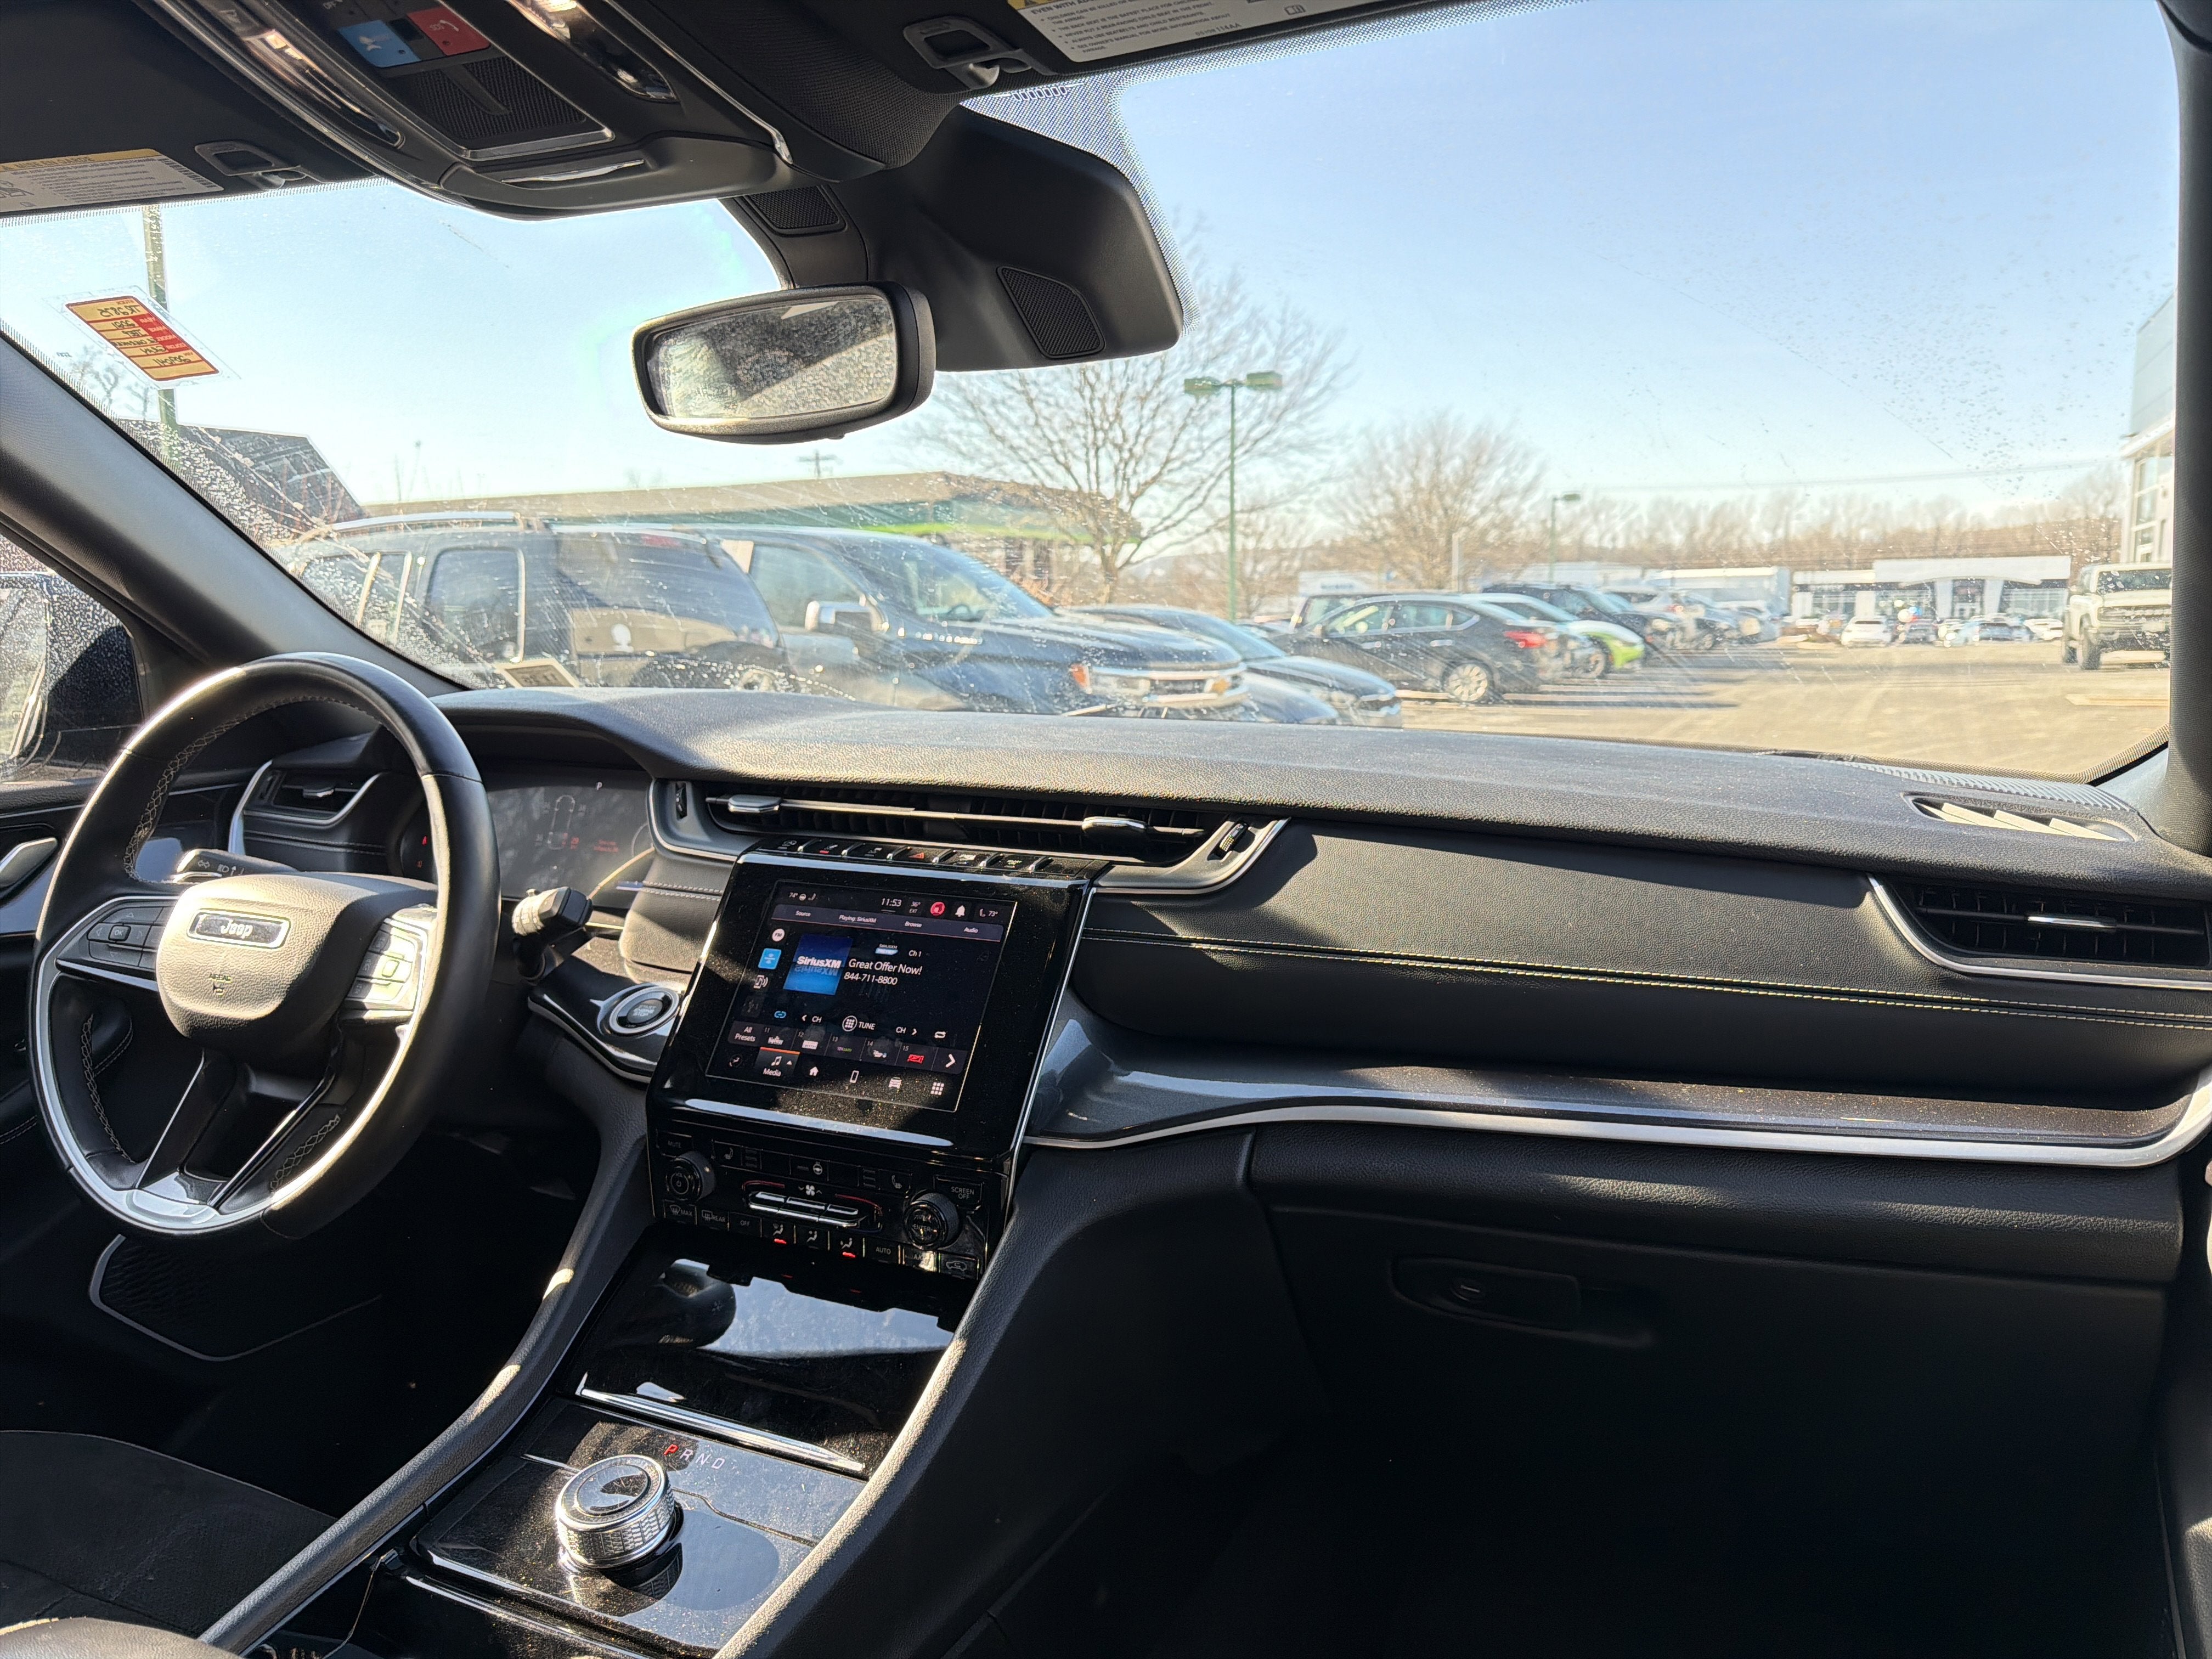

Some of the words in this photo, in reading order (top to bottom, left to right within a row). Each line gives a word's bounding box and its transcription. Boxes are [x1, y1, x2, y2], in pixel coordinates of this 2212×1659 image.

[596, 781, 602, 790] P
[881, 898, 902, 907] 11:53
[221, 919, 253, 939] Jeep
[797, 956, 842, 968] SiriusXM
[849, 959, 872, 969] Great
[874, 961, 896, 972] Offer
[898, 964, 923, 975] Now!
[844, 972, 898, 985] 844-711-8800
[858, 1022, 876, 1030] TUNE
[735, 1033, 756, 1042] Presets
[763, 1068, 782, 1076] Media
[668, 1140, 681, 1148] MUTE
[951, 1186, 975, 1195] SCREEN
[913, 1223, 931, 1232] ENTER
[876, 1246, 891, 1255] AUTO
[664, 1443, 679, 1456] P
[680, 1448, 694, 1461] R
[695, 1453, 712, 1465] N
[711, 1457, 725, 1469] D
